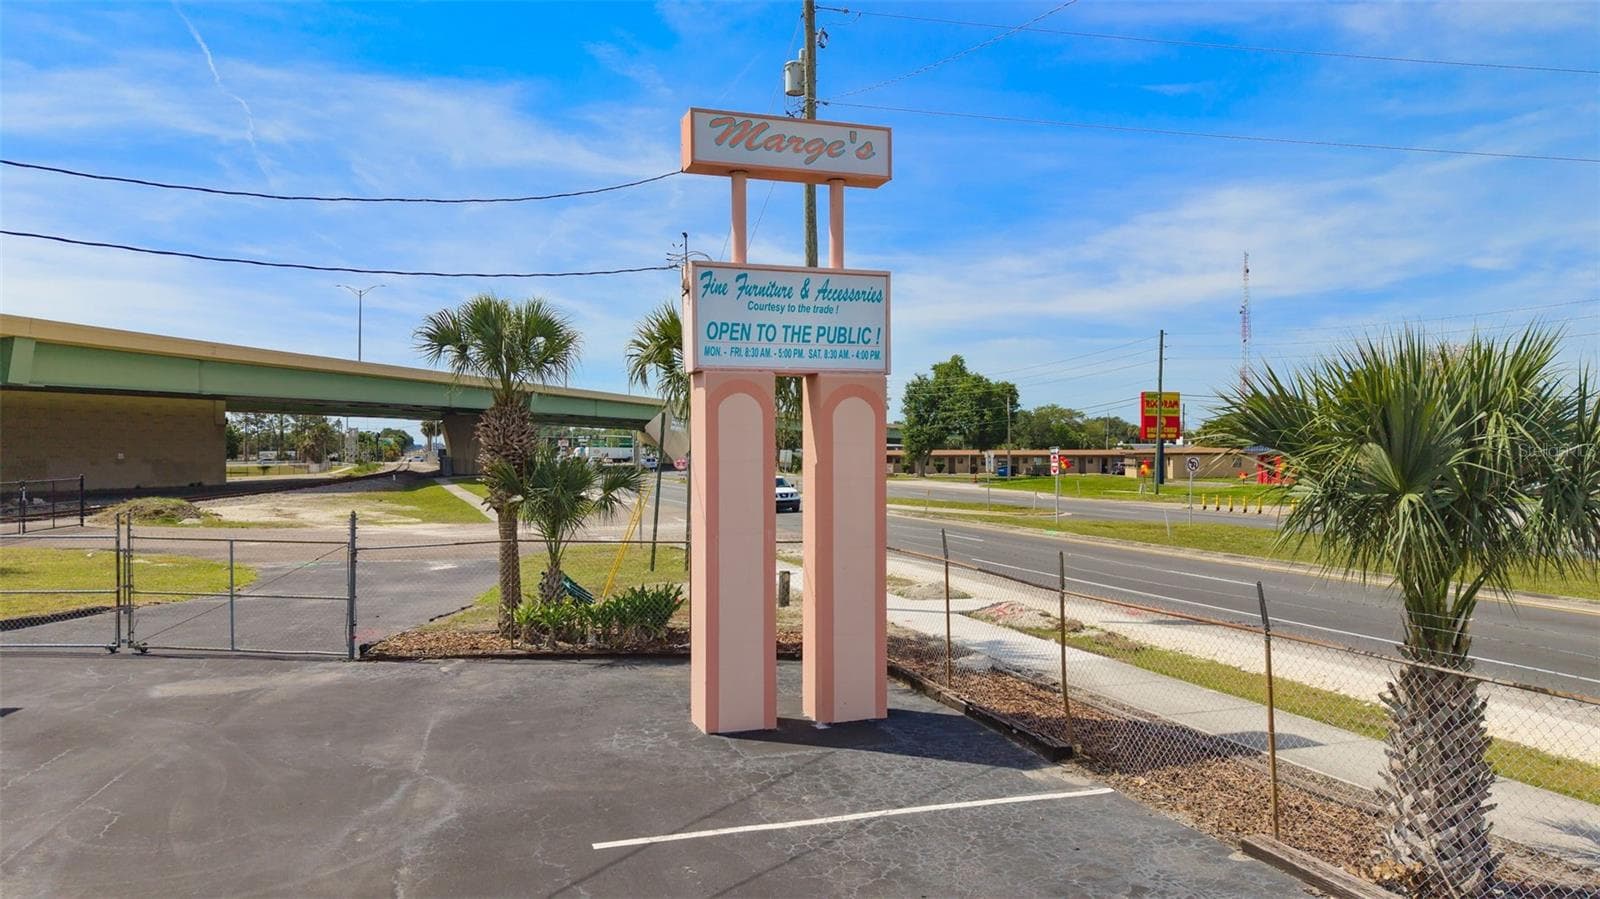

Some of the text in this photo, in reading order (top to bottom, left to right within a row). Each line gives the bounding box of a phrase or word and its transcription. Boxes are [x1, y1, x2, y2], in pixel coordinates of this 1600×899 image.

[709, 117, 876, 165] Marge's
[700, 270, 884, 304] Fine Furniture & Accessories
[747, 300, 785, 314] Courtesy
[788, 303, 796, 313] to
[798, 303, 811, 313] the
[813, 304, 834, 314] trade
[706, 321, 881, 345] OPEN TO THE PUBLIC !
[704, 345, 722, 356] MON.
[730, 346, 742, 357] FRI.
[744, 347, 759, 358] 8:30
[778, 348, 792, 358] 5:00
[807, 349, 821, 359] SAT.
[824, 349, 837, 359] 8:30
[855, 350, 869, 360] 4:00
